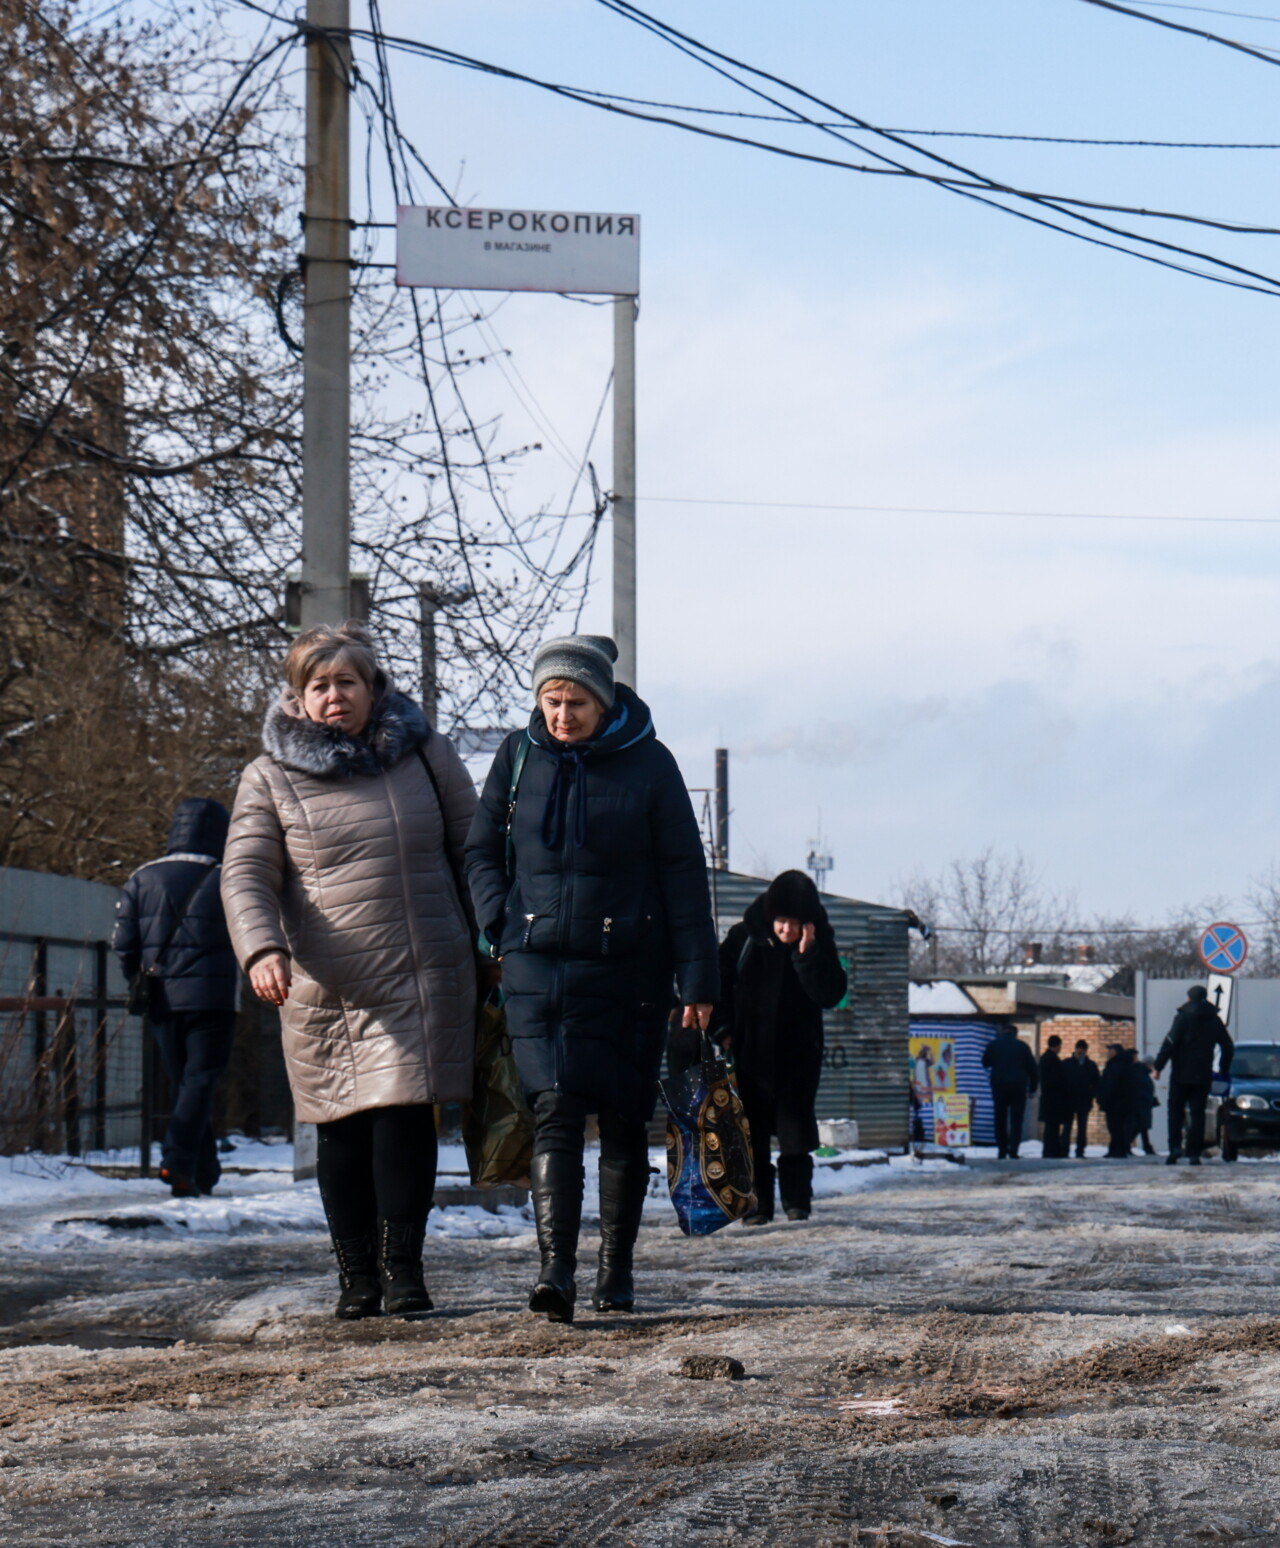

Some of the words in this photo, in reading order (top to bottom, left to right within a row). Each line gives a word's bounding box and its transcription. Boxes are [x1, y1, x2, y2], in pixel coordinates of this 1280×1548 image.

[426, 208, 635, 236] КСЕРОКОПИЯ
[484, 241, 492, 251] В
[494, 242, 552, 254] МАГАЗИНЕ
